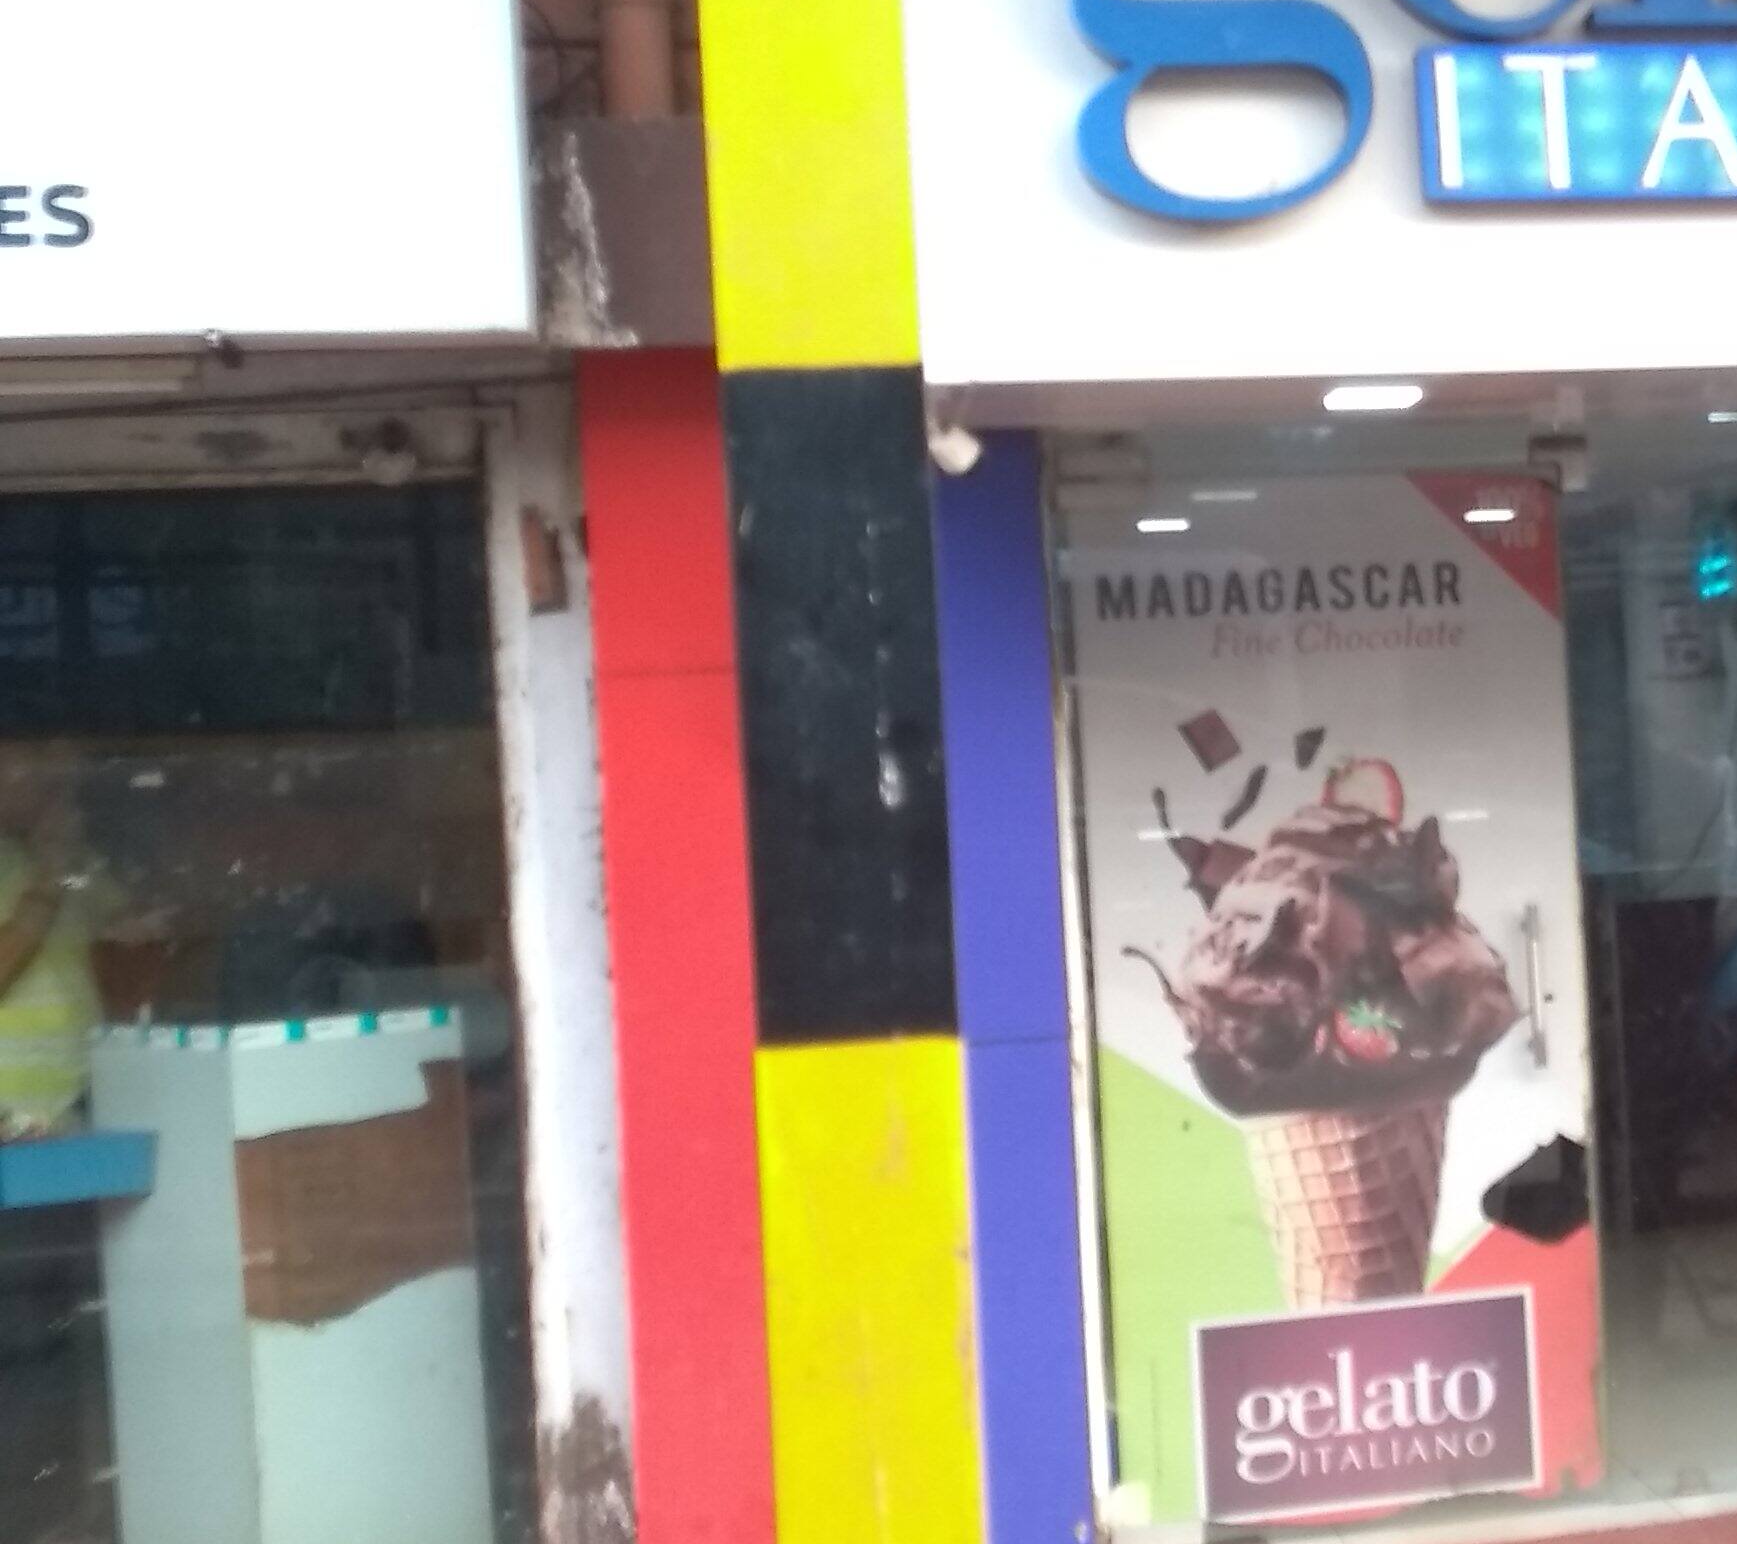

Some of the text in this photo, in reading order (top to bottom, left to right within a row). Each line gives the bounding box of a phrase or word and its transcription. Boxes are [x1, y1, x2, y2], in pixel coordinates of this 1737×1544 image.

[1096, 561, 1462, 620] MADAGASCAR
[1236, 1350, 1497, 1484] gelato
[1300, 1429, 1496, 1477] ITALIANO
